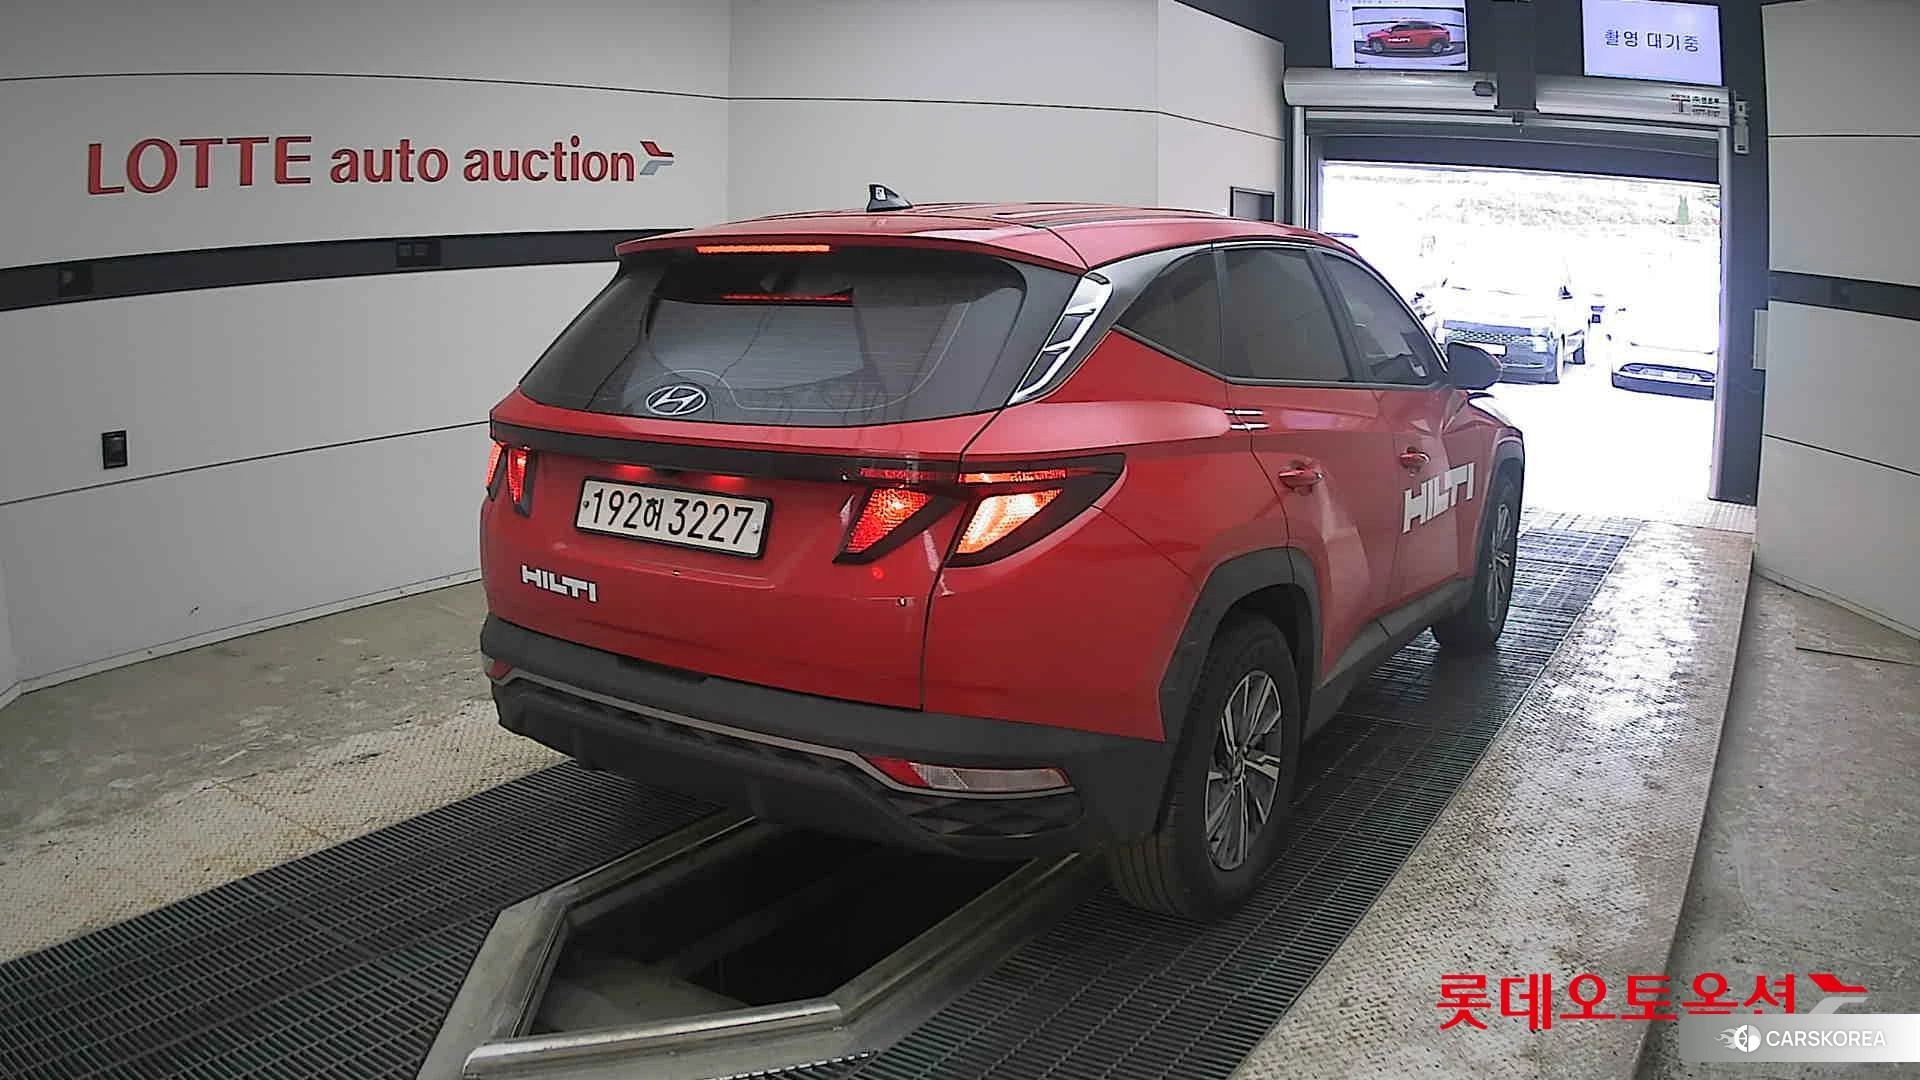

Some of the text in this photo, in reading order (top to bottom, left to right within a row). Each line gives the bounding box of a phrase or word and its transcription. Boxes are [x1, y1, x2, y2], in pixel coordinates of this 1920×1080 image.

[1647, 32, 1698, 52] 대기중
[87, 135, 635, 195] LOTTE auto auction
[1402, 462, 1475, 534] HILTI
[521, 565, 597, 602] HILTI
